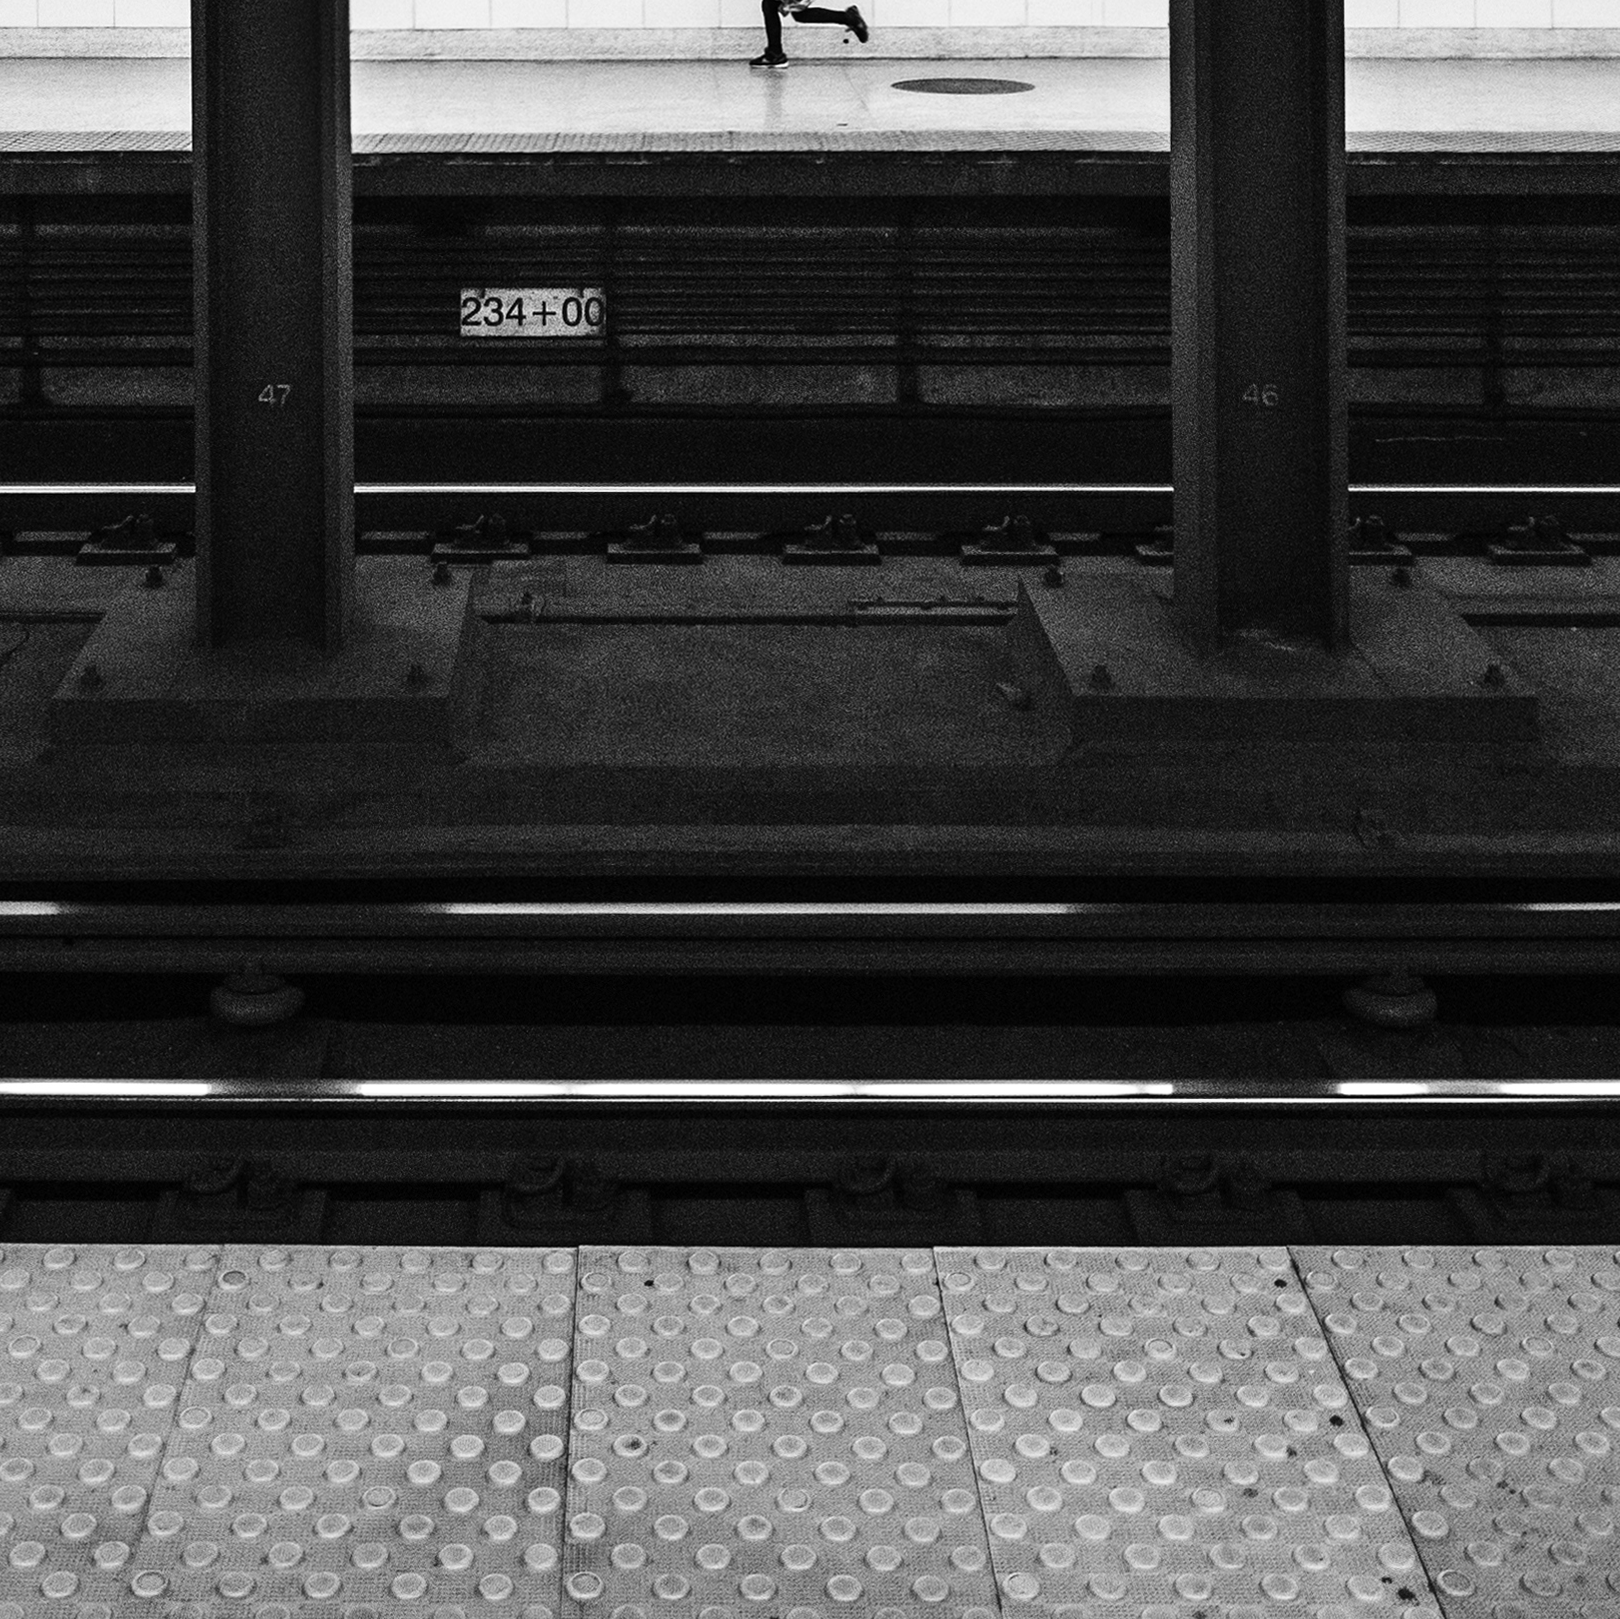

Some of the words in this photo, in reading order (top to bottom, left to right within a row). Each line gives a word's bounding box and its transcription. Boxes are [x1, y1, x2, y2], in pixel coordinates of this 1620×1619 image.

[461, 296, 605, 327] 234+00
[257, 383, 291, 406] 47
[1241, 383, 1279, 407] 46
